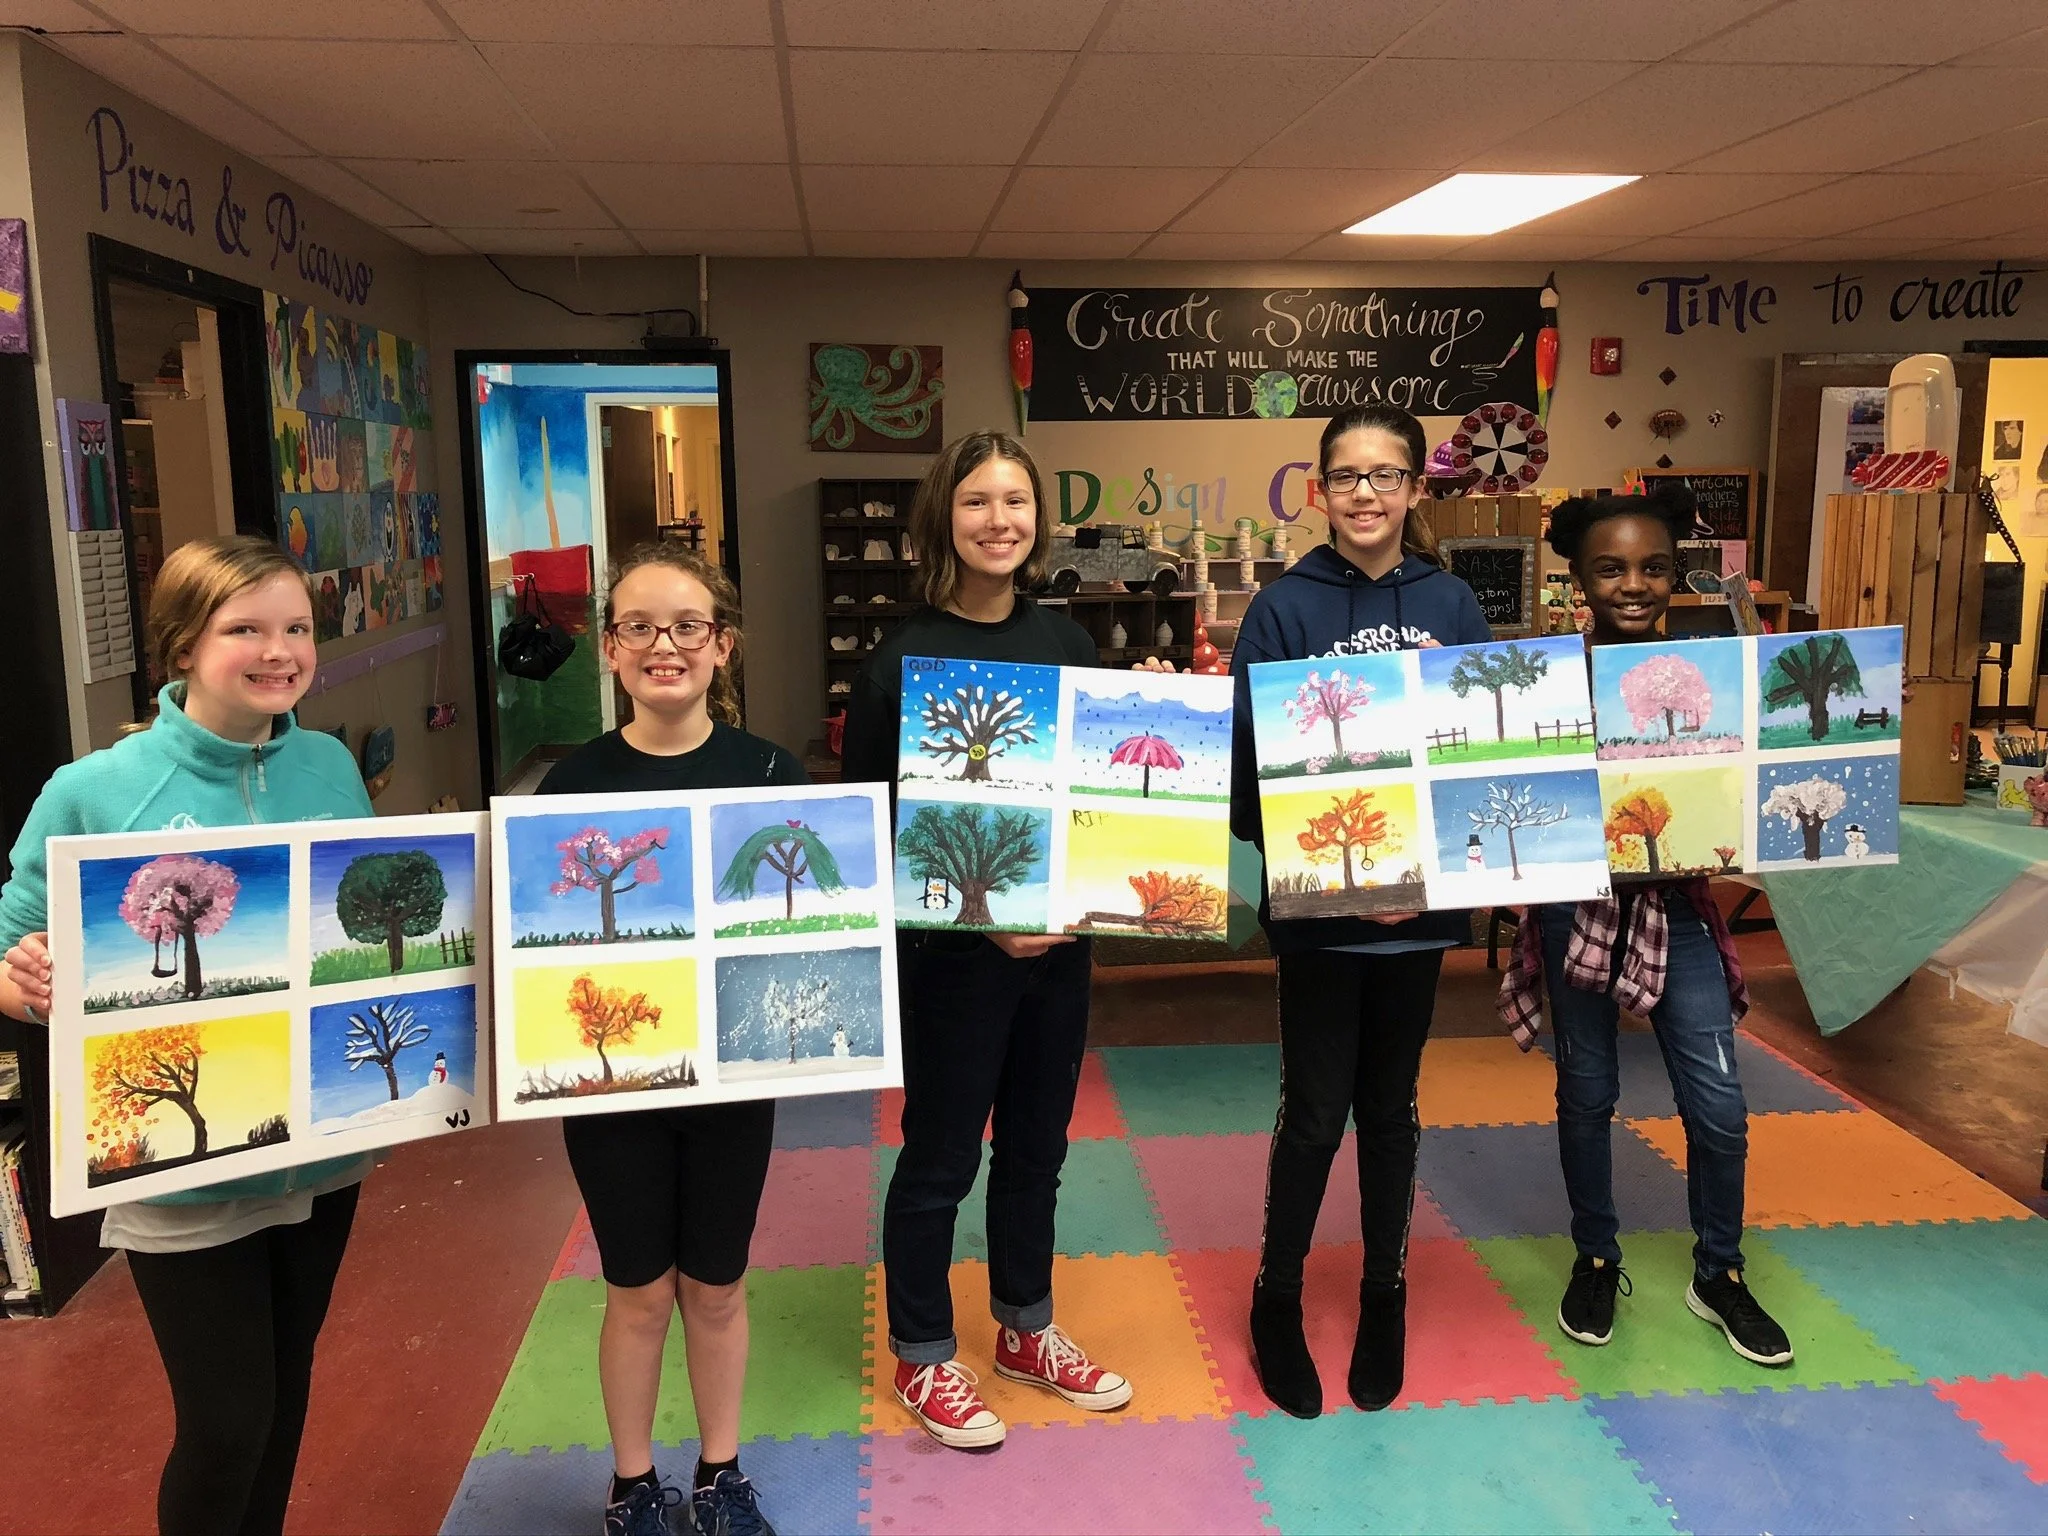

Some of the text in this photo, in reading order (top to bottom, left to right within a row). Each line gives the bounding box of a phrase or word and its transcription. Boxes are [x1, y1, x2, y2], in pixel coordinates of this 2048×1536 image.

[86, 106, 374, 306] Pizza & Picasso
[1814, 273, 1873, 325] to
[1890, 260, 2046, 322] create
[1067, 289, 1484, 368] Create Something
[1166, 350, 1378, 371] THAT WILL MAKE THE
[1077, 372, 1450, 417] WORLD awesome
[1470, 555, 1503, 574] Ask
[1480, 597, 1515, 618] signs!
[445, 1108, 471, 1129] VJ
